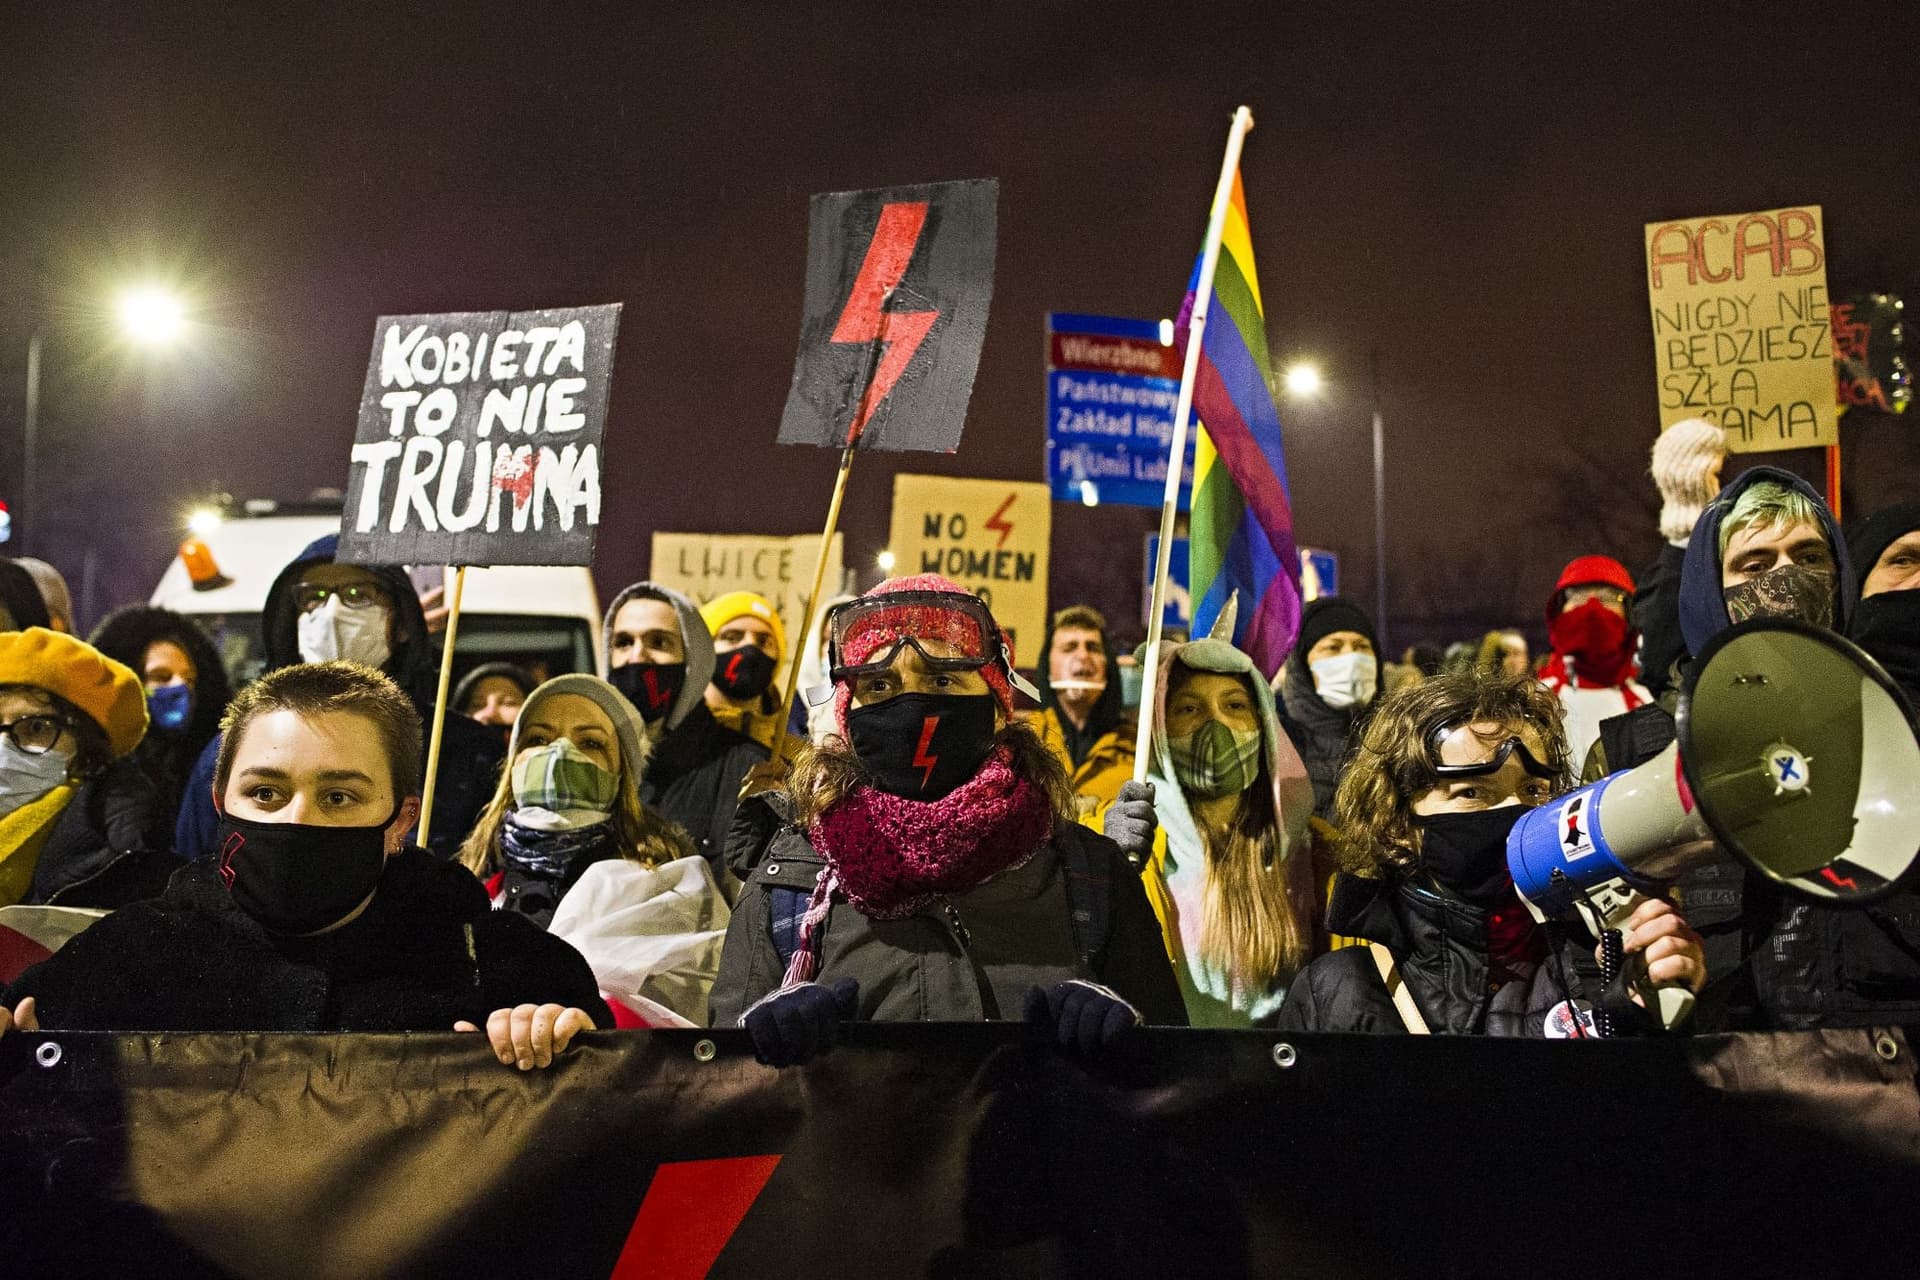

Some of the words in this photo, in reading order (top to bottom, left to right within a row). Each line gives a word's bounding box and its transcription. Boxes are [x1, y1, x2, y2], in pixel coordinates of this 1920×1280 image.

[1650, 210, 1823, 289] ACAB
[1654, 293, 1756, 335] NIGDY
[1777, 285, 1829, 322] NIE
[380, 319, 586, 389] KOBIETA
[1667, 322, 1830, 375] BĘDZIESZ
[380, 387, 458, 437] TO
[477, 377, 587, 437] NIE
[1662, 367, 1759, 411] SZŁA
[1057, 406, 1133, 438] Zakład
[351, 435, 601, 534] TRUMNA
[923, 511, 967, 541] NO
[678, 547, 794, 583] LWICE
[921, 546, 1035, 582] WOMEN
